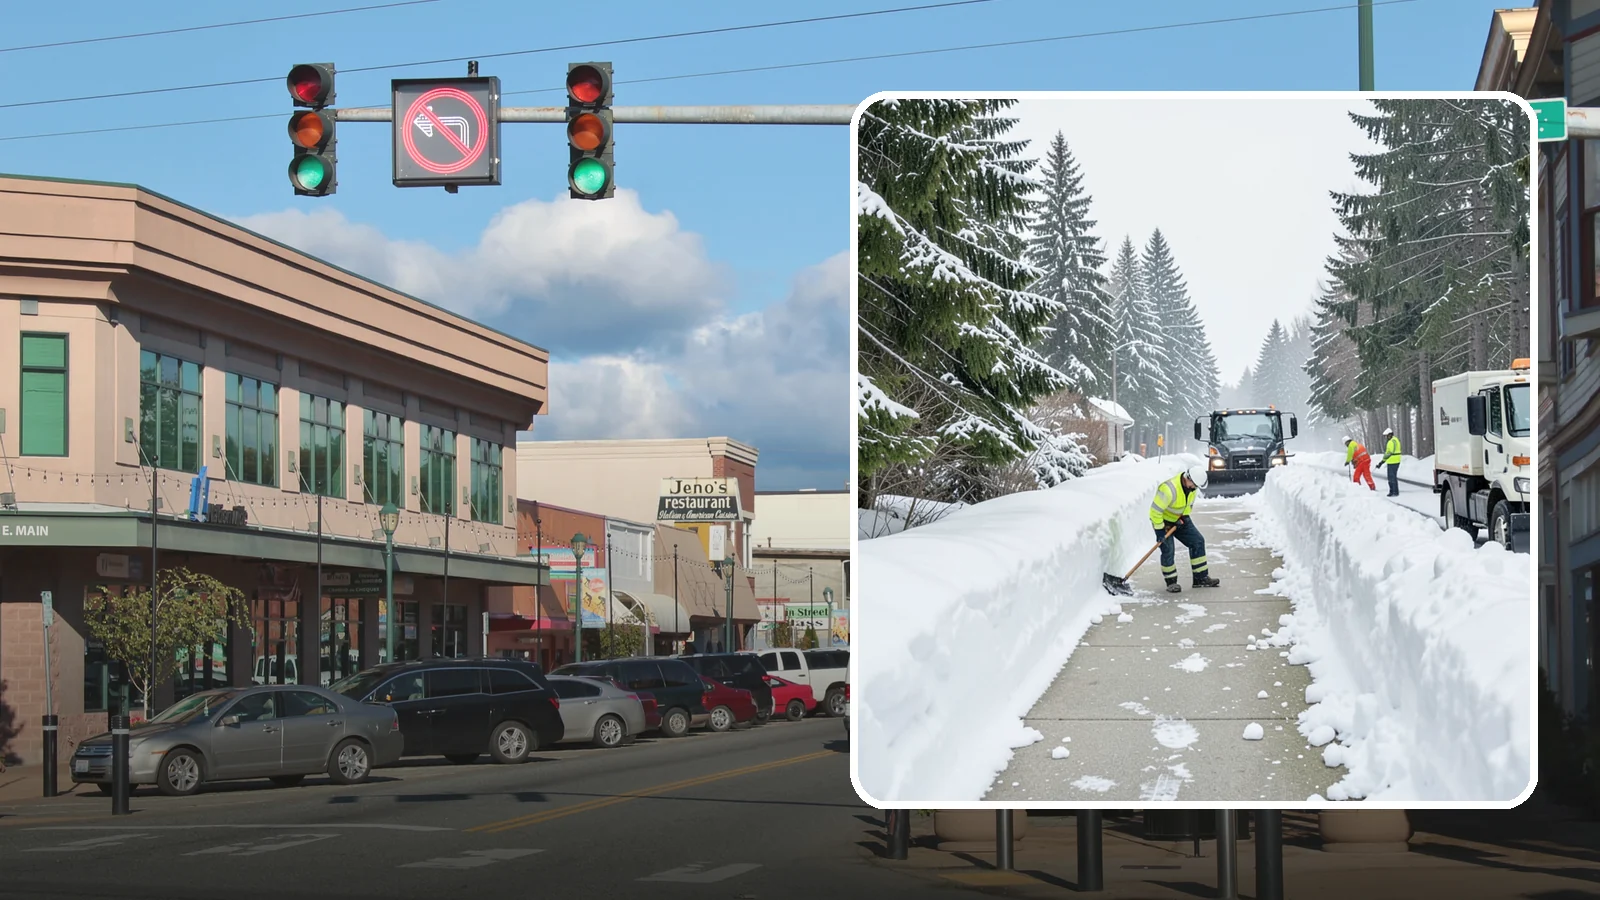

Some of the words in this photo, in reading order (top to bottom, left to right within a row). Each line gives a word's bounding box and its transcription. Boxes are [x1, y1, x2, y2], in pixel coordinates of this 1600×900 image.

[670, 480, 728, 494] Jeno's
[665, 496, 731, 509] restaurant
[686, 510, 715, 520] American
[715, 510, 737, 519] Cuisine
[2, 525, 13, 536] E.
[15, 525, 49, 536] MAIN
[797, 608, 828, 617] Street
[790, 619, 824, 627] lass
